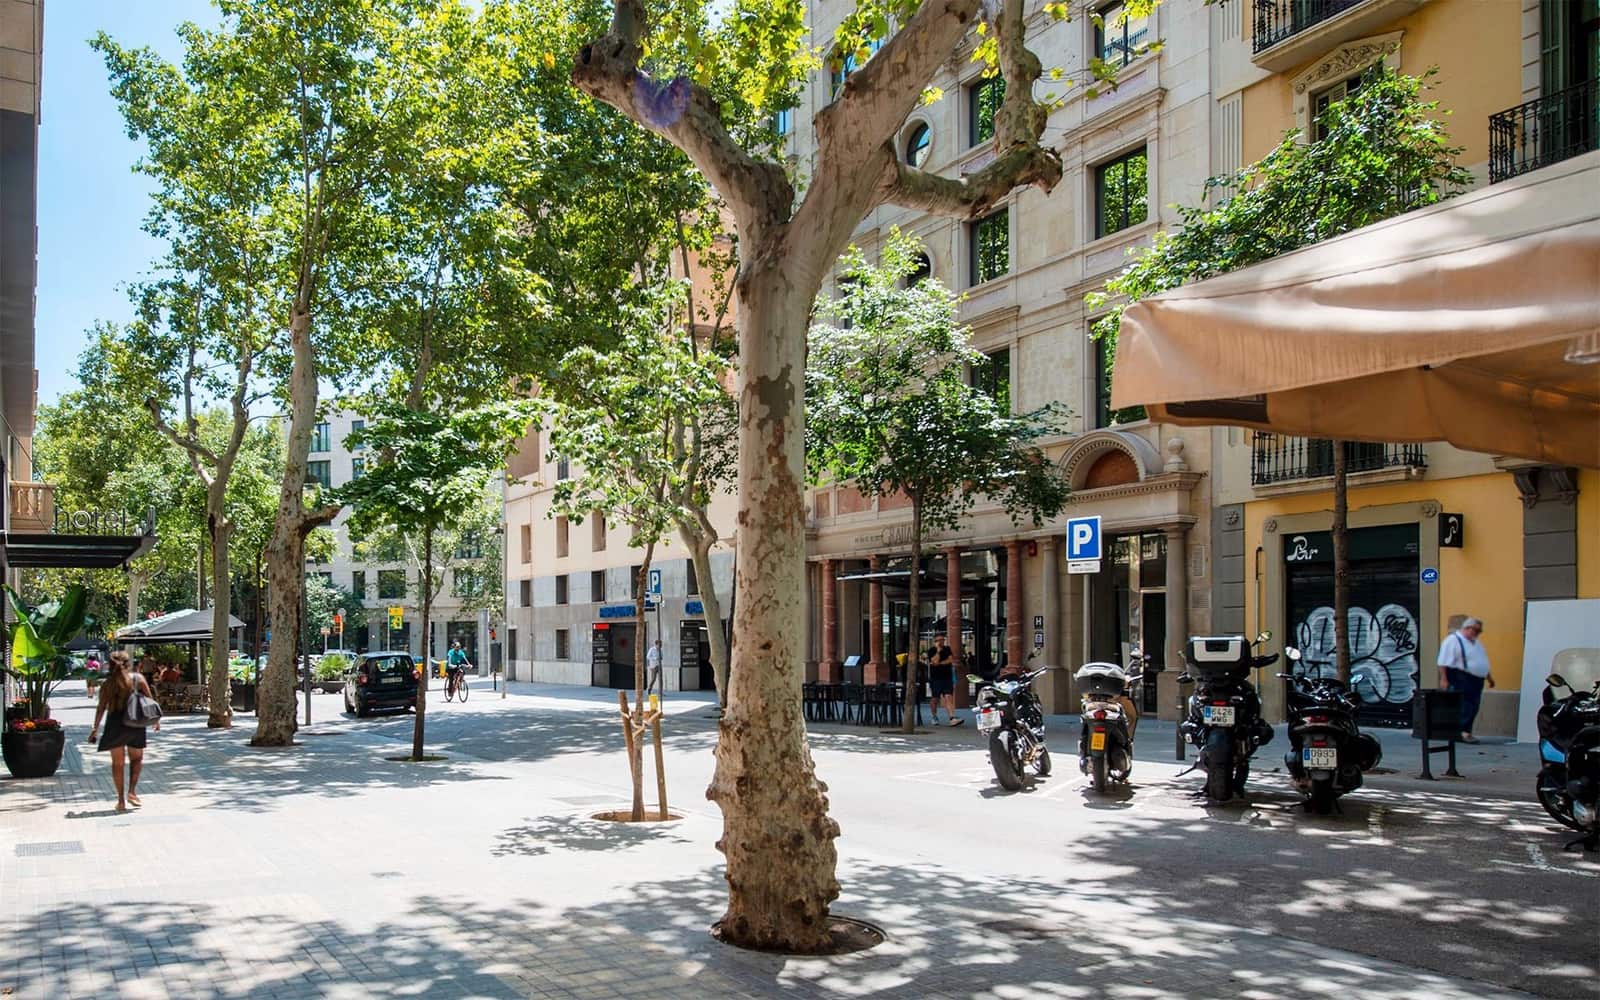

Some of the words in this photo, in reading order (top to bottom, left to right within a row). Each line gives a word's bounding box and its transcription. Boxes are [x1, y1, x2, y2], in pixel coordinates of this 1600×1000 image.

[55, 505, 126, 532] hotel
[1073, 523, 1093, 555] P
[651, 571, 660, 592] P
